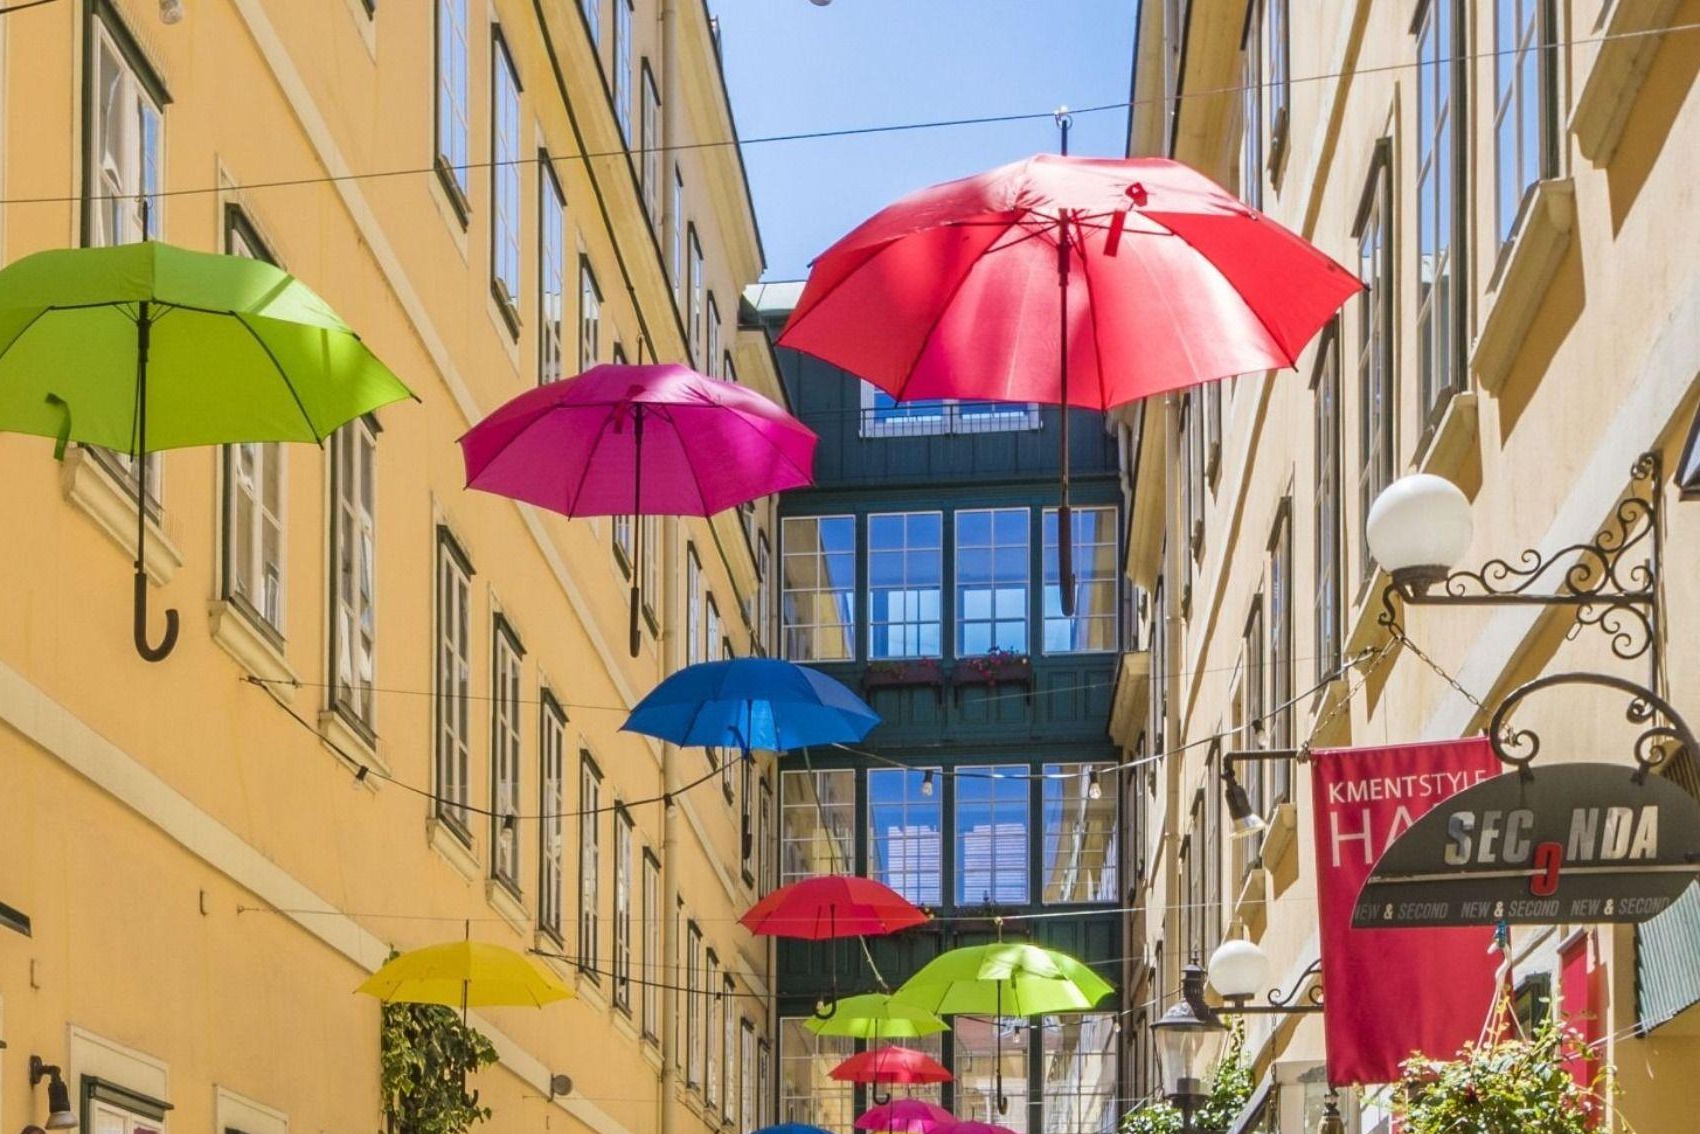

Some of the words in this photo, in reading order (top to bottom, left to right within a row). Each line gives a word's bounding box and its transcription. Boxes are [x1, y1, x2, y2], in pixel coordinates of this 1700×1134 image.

[1444, 805, 1659, 896] SECONDA
[1383, 902, 1394, 920] &
[1398, 902, 1448, 920] SECOND
[1460, 901, 1490, 919] NEW
[1493, 901, 1504, 918] &
[1508, 900, 1559, 918] SECOND
[1570, 899, 1601, 917] NEW
[1603, 898, 1615, 916] &
